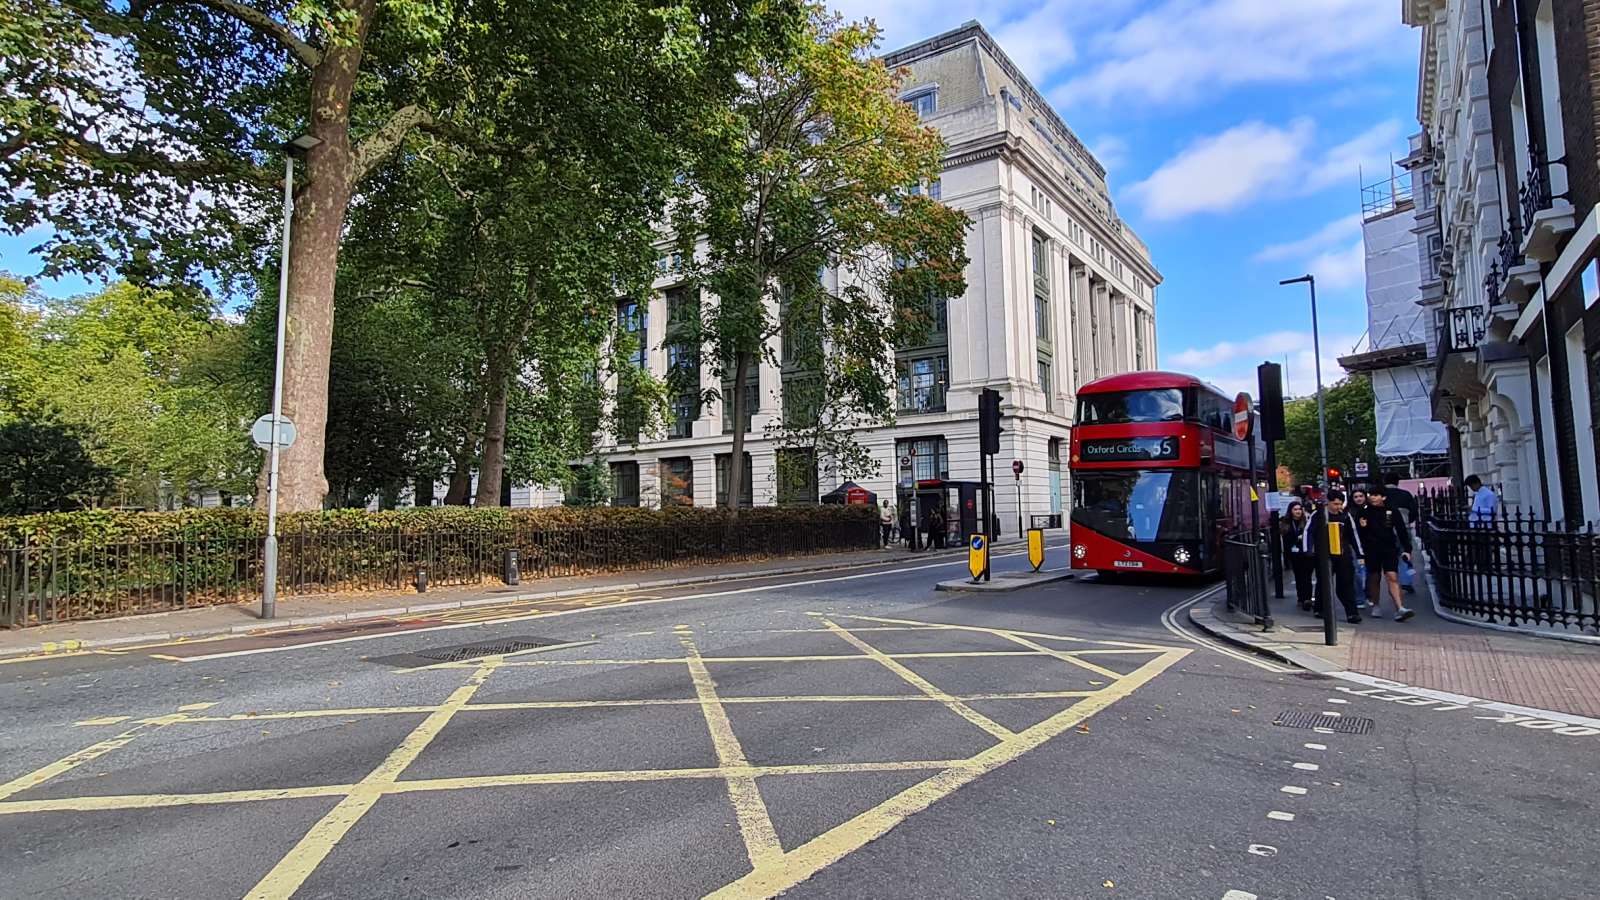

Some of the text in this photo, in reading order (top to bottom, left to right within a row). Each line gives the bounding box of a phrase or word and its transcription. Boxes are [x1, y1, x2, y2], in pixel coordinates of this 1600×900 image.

[1087, 444, 1141, 454] Oxford Circus
[1152, 439, 1172, 455] 55
[1336, 687, 1600, 736] OOK LEFT
